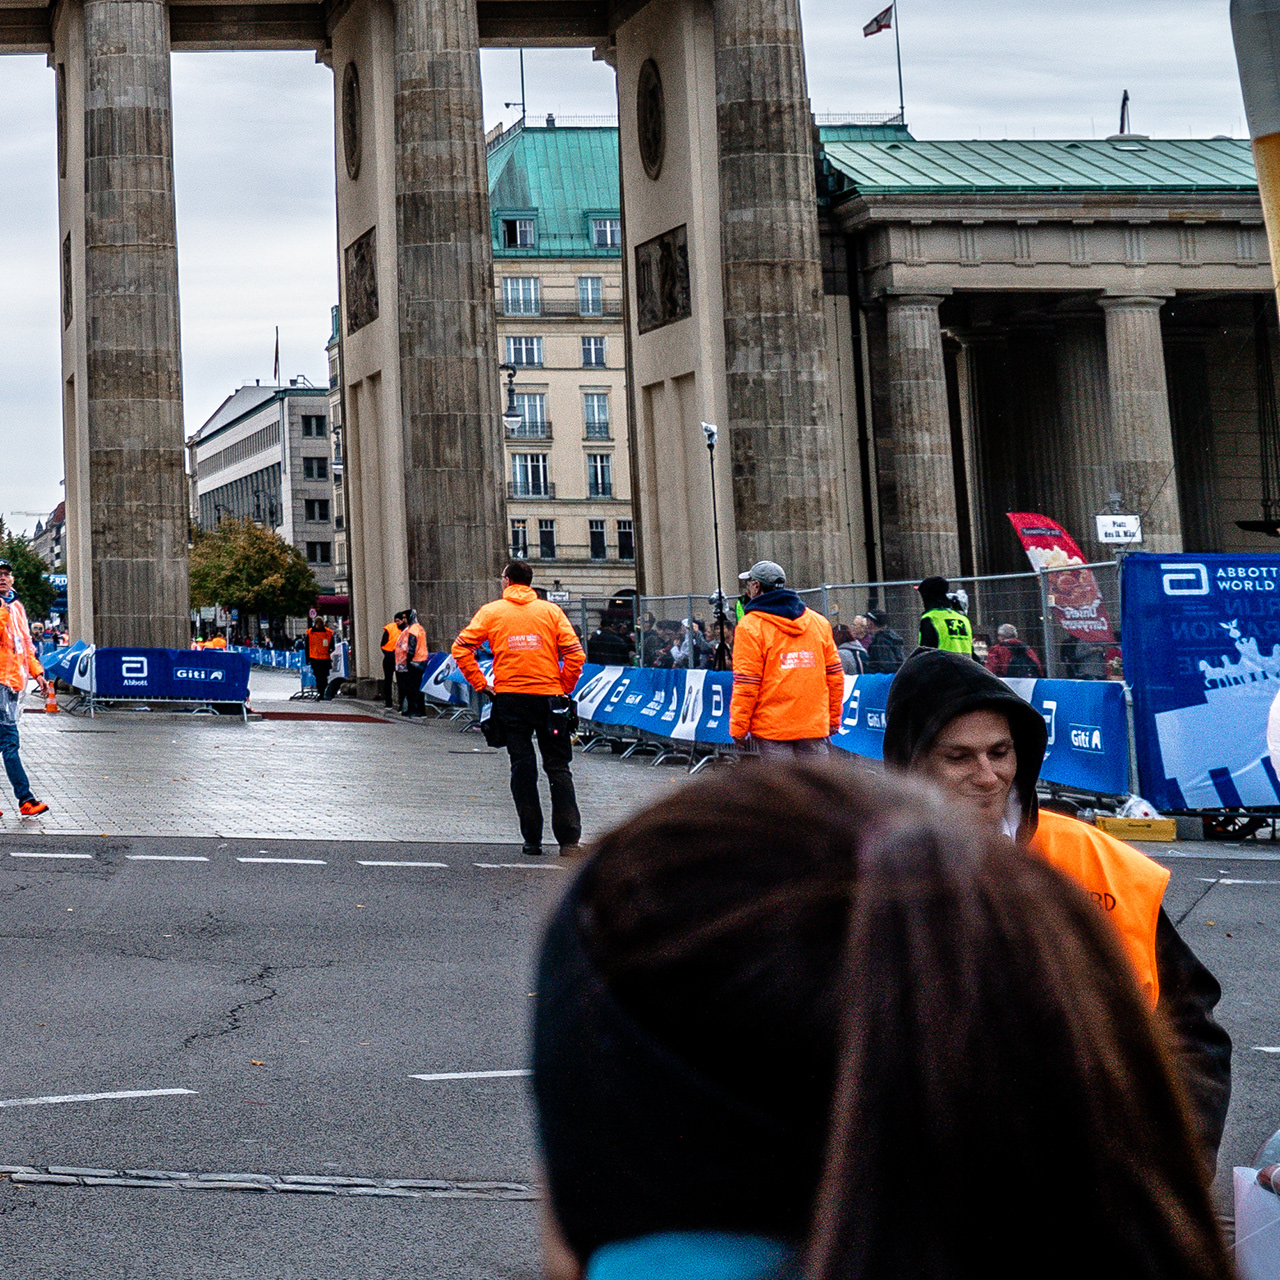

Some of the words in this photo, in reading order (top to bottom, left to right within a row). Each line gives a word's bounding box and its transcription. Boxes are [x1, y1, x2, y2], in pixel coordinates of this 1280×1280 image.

[1216, 567, 1278, 578] ABBOTT
[1216, 580, 1275, 591] WORLD
[176, 669, 206, 679] Giti
[1071, 729, 1090, 748] Giti
